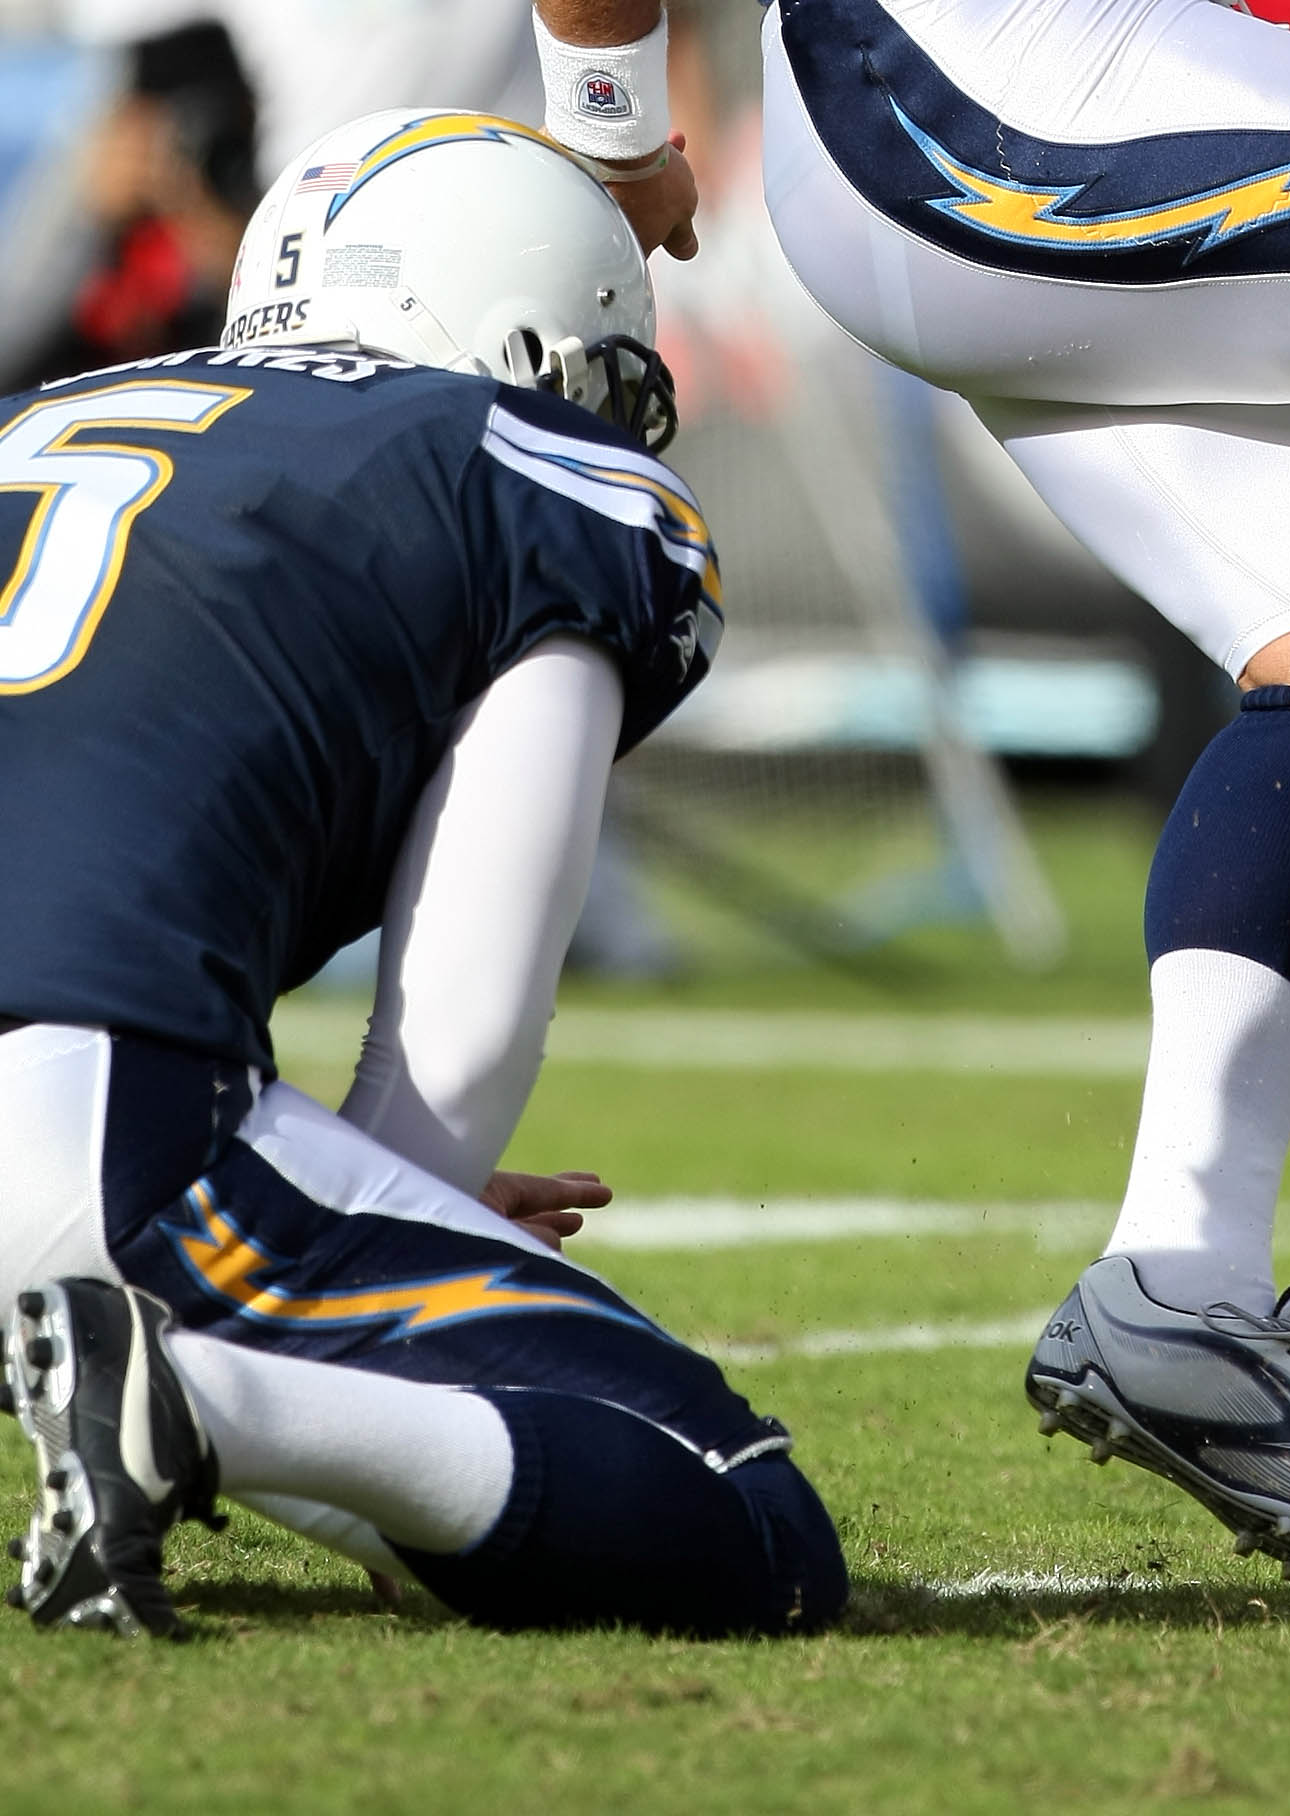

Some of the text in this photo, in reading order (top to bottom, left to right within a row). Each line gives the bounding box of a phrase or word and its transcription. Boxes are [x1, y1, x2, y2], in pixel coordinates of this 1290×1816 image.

[275, 232, 305, 290] 5
[401, 297, 416, 312] 5
[0, 379, 253, 696] 5
